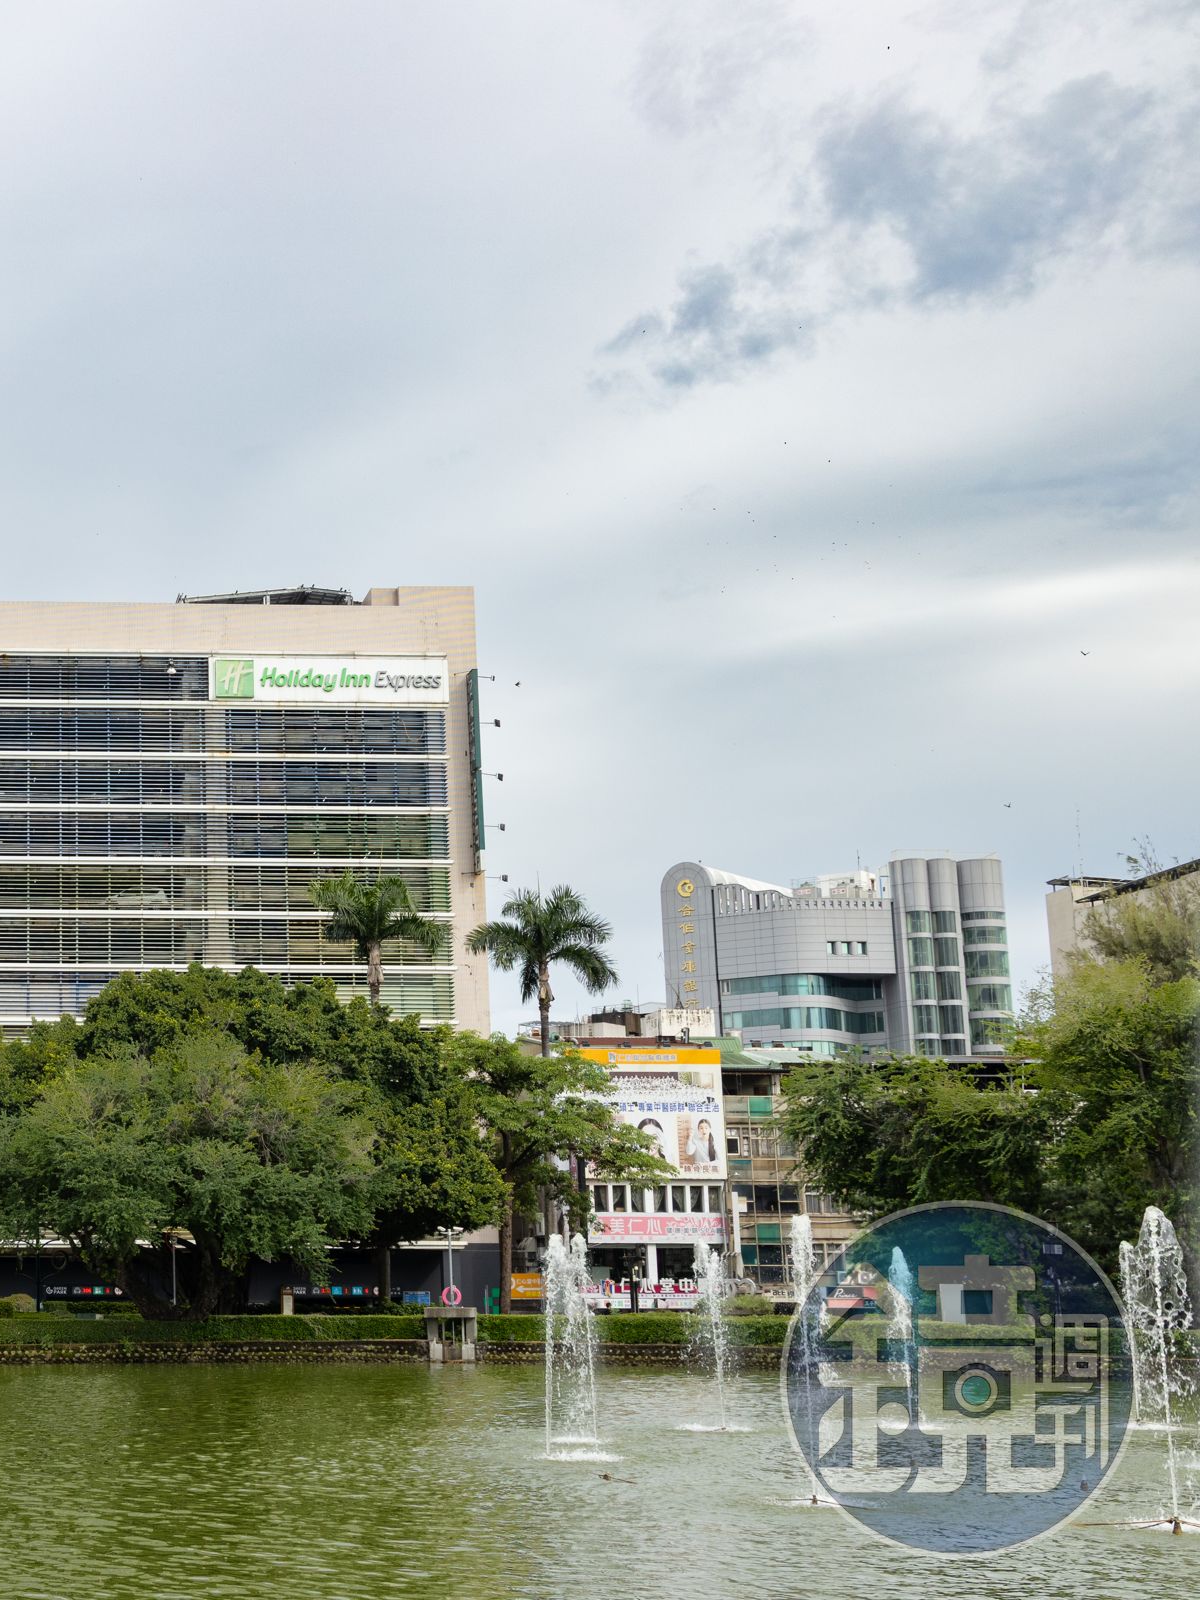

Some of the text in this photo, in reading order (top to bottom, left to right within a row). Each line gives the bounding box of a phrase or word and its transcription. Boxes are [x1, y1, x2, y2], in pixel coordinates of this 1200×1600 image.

[260, 667, 442, 692] Holiday Inn Express
[678, 904, 699, 1008] 合作金庫銀行
[611, 1219, 663, 1234] 美仁心
